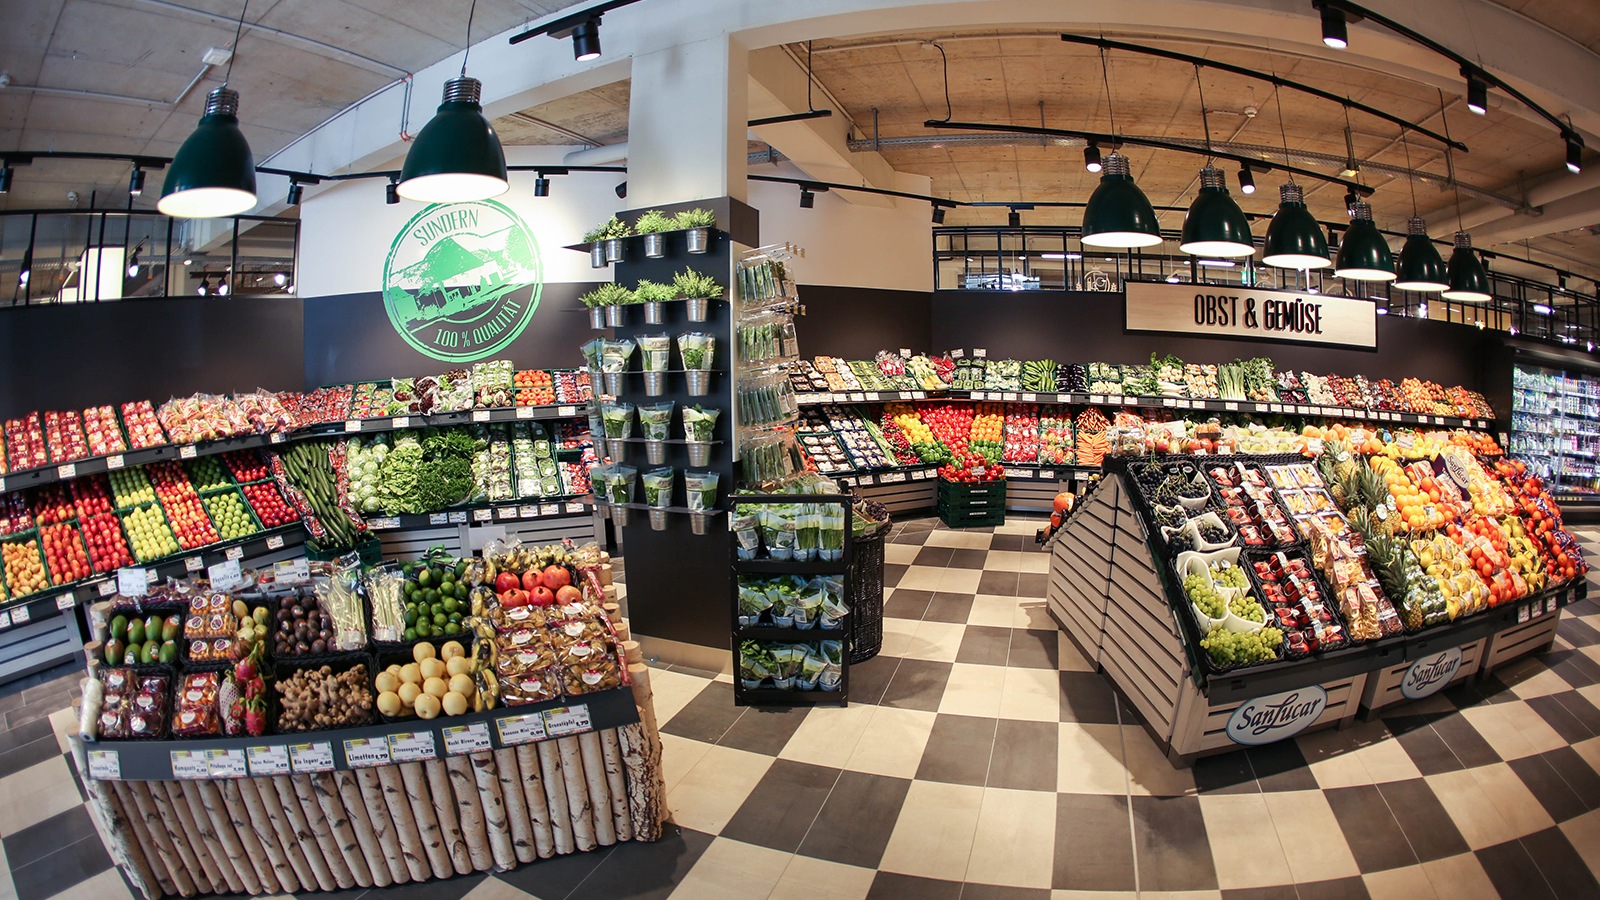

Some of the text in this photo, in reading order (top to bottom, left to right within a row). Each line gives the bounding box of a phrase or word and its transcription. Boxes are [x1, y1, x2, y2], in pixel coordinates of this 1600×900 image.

[413, 209, 479, 247] SUNDERN
[433, 298, 521, 348] 100 % QUALITÄT
[1194, 294, 1322, 334] OBST & GEMÜSE
[1407, 652, 1460, 691] SanLucar
[575, 719, 589, 727] 1,79
[1236, 692, 1322, 736] SanLucar
[348, 753, 375, 762] Limetten
